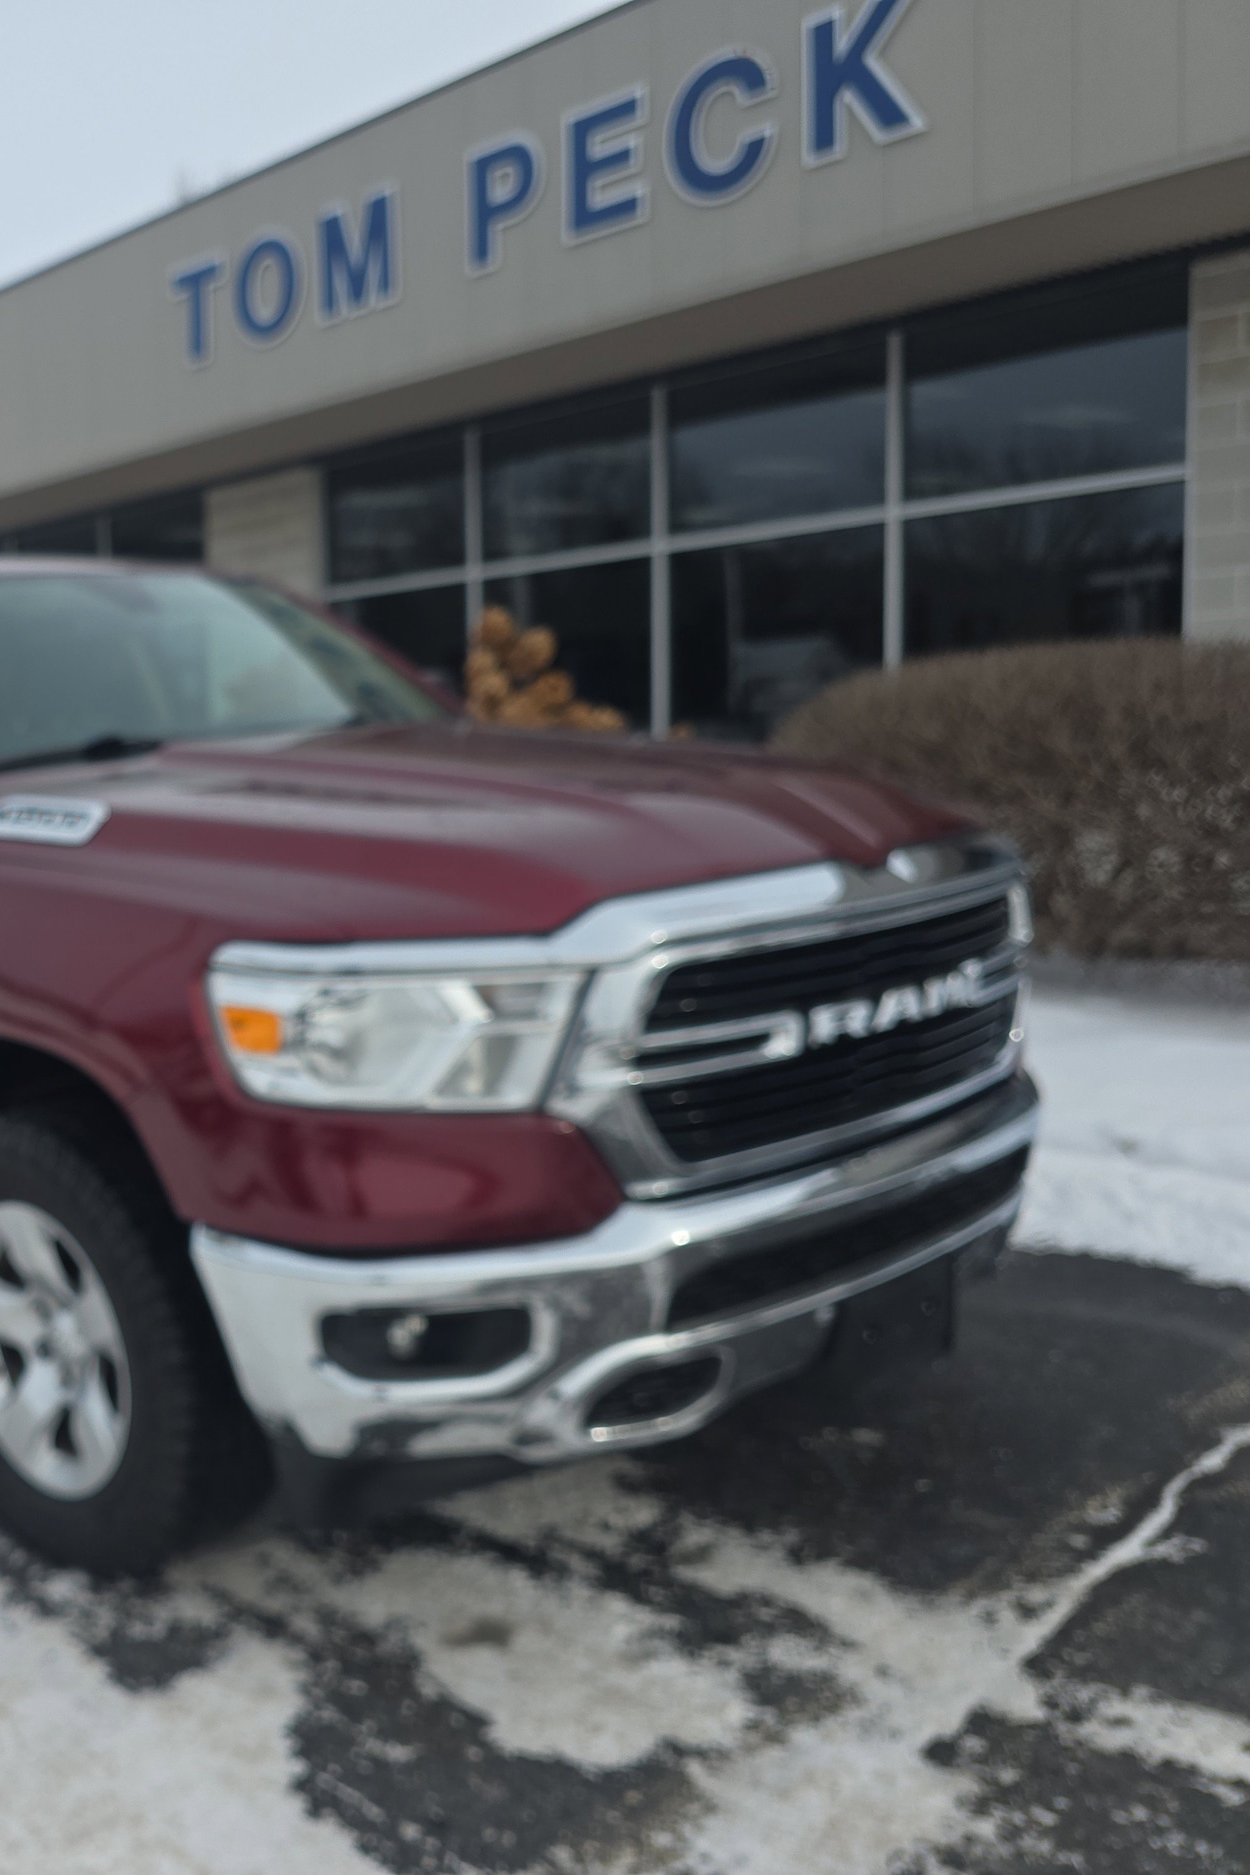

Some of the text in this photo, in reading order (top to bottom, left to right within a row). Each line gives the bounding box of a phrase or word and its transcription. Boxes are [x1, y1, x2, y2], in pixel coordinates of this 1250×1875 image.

[170, 0, 924, 366] TOM PECK
[808, 966, 974, 1048] RAM
